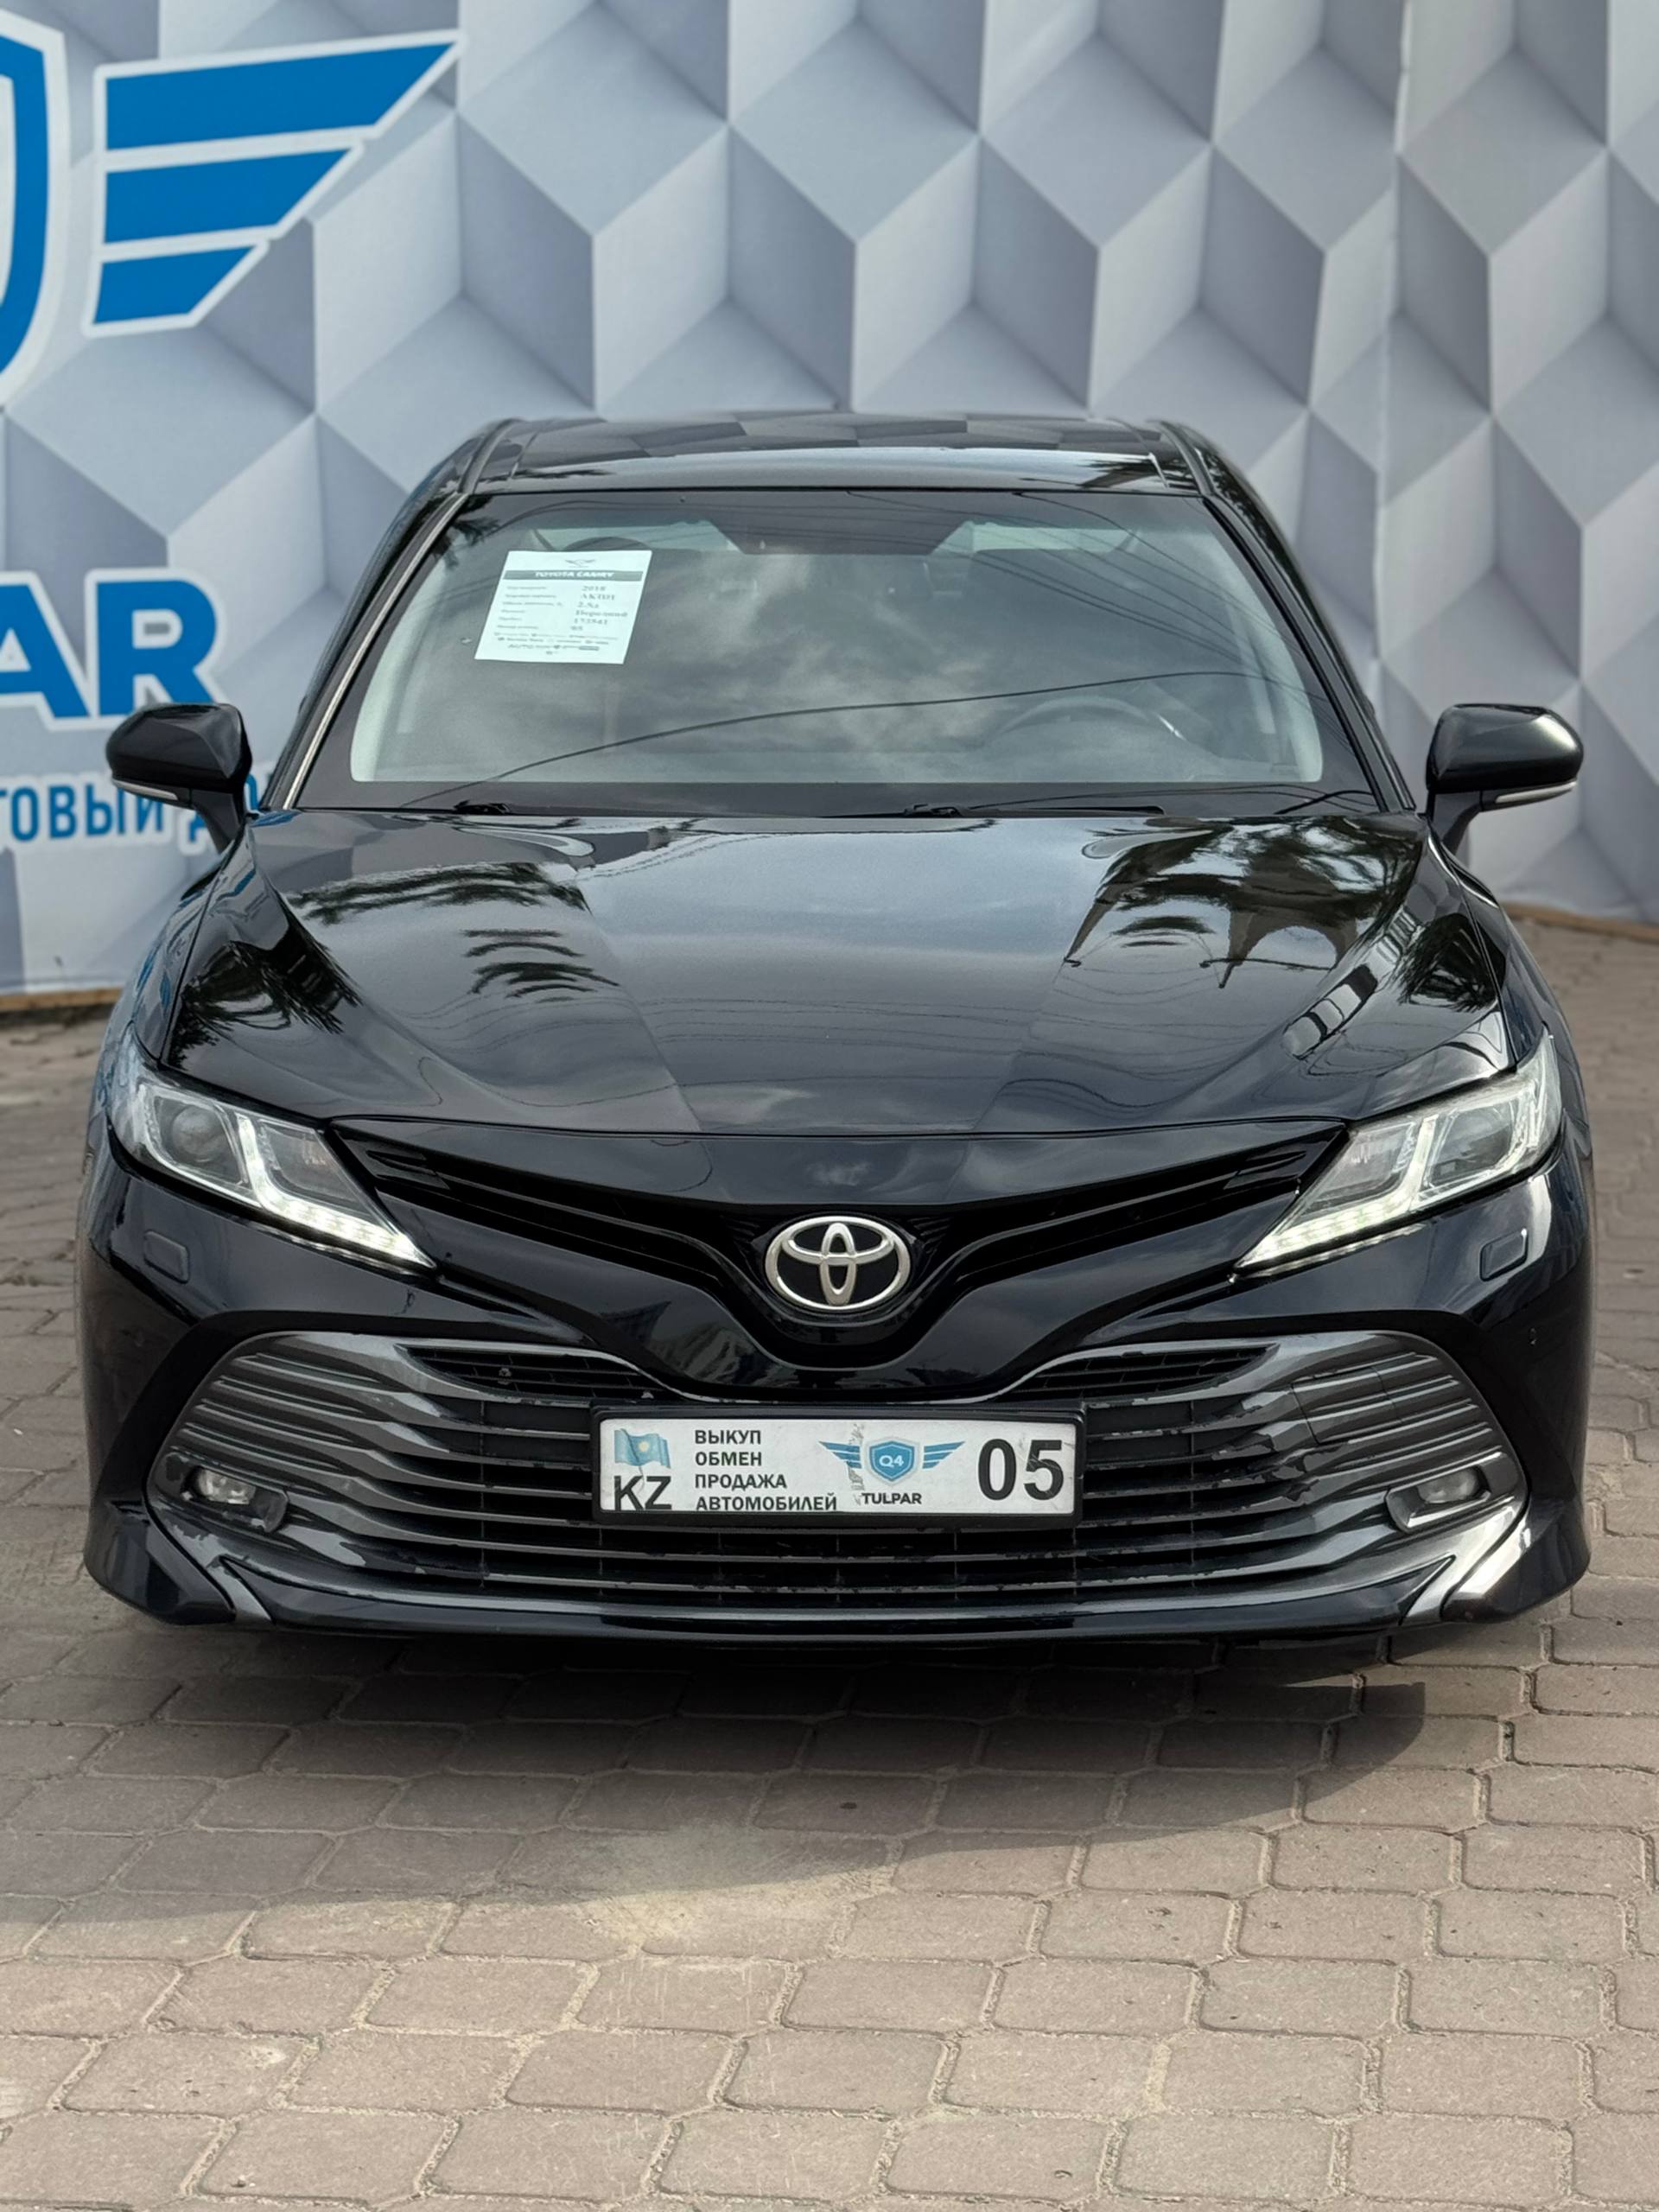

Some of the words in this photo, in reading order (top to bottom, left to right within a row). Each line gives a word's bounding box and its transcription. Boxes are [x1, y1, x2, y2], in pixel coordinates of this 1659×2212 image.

[694, 1430, 761, 1445] ВЫКУП
[695, 1452, 762, 1466] ОБМЕН
[977, 1439, 1065, 1501] 05
[694, 1474, 787, 1491] ПРОДАЖА
[613, 1475, 672, 1511] KZ
[696, 1492, 836, 1510] АВТОМОБИЛЕЙ
[861, 1492, 922, 1504] TULPAR
